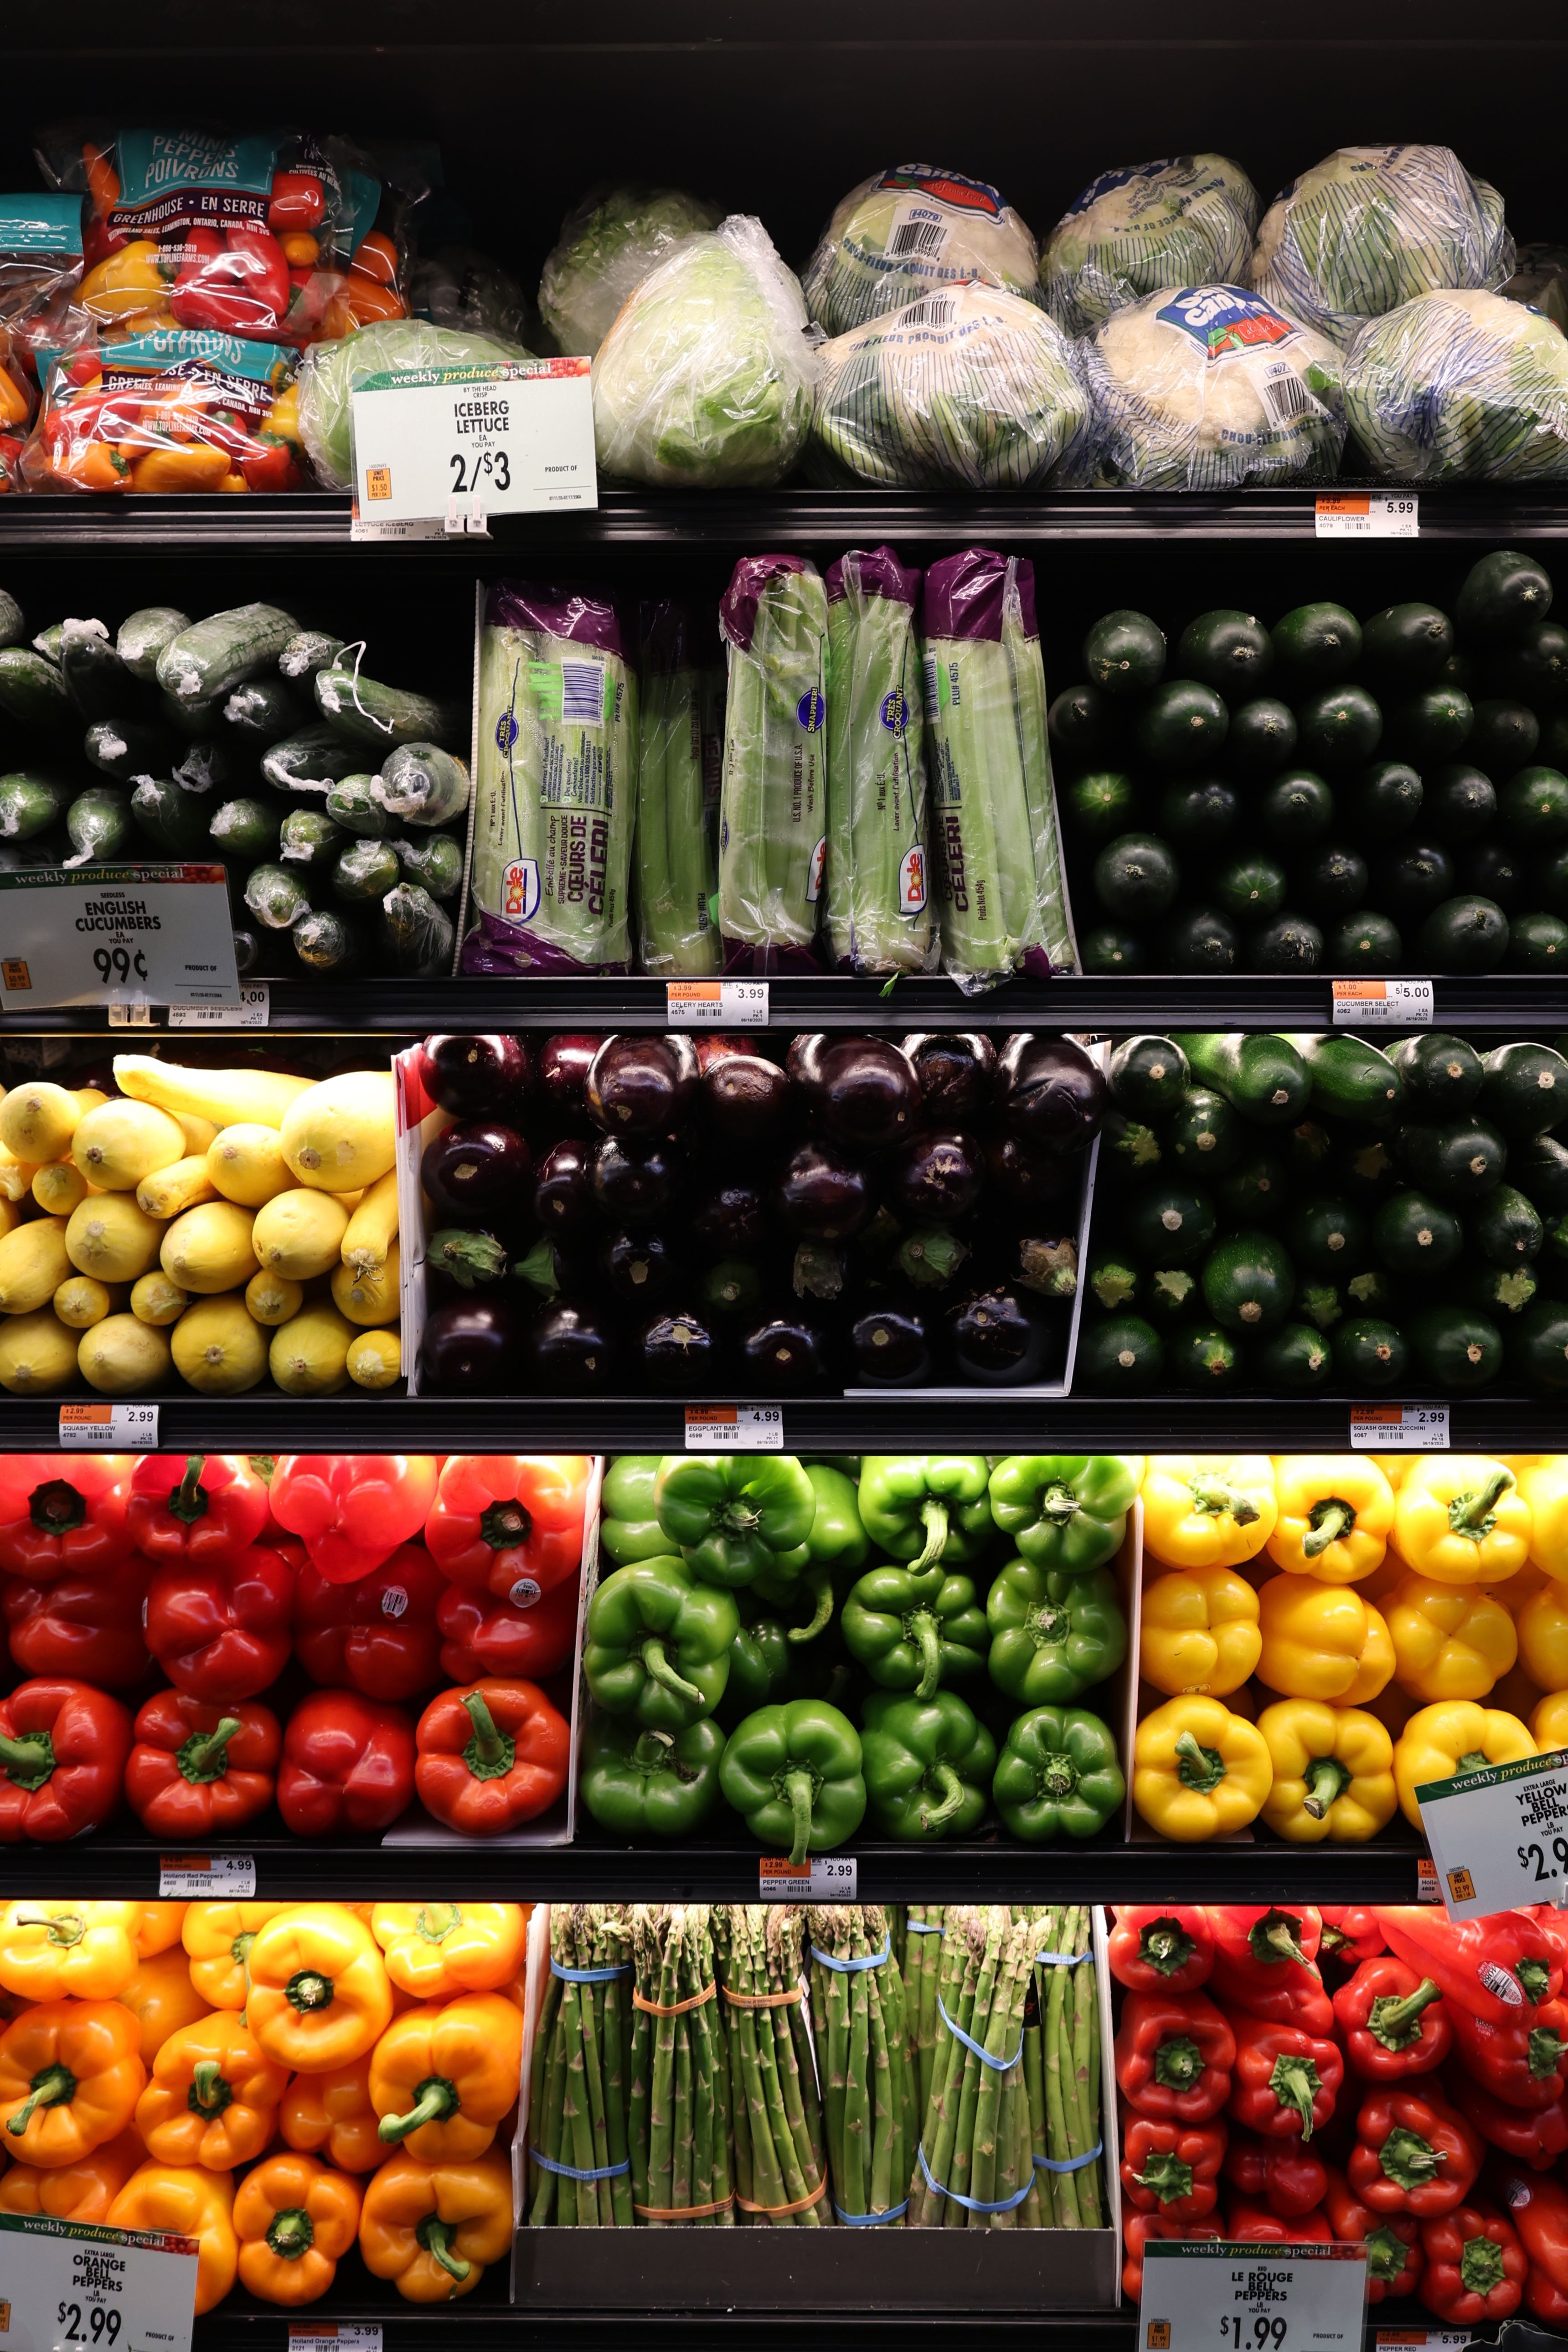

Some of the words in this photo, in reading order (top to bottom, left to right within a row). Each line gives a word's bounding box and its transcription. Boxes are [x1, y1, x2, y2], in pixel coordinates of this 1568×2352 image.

[145, 159, 239, 188] POIVRONS
[113, 197, 183, 224] GREENHOUSE
[201, 196, 217, 210] EN
[223, 198, 264, 217] SERRE
[912, 209, 939, 220] #4079
[193, 217, 218, 228] ONTARIO,
[220, 219, 244, 230] CANADA,
[259, 227, 270, 236] 3V5
[146, 253, 210, 264] WWW.TOPLINEFARMS.COM
[937, 268, 956, 279] DES
[849, 335, 903, 352] CHOU-FLEUR
[908, 330, 954, 345] PRODUIT
[391, 370, 439, 384] weekly
[443, 367, 498, 383] produce
[502, 362, 552, 380] special
[454, 401, 509, 417] ICEBERG
[457, 417, 509, 433] LETTUCE
[949, 662, 958, 683] 4575
[951, 685, 960, 706] PLU#
[807, 687, 819, 732] SNAPPIER!
[884, 699, 895, 722] TRÈS
[892, 685, 903, 739] CROQUANT
[498, 721, 506, 743] TRÈS
[502, 705, 512, 758] CROQUANT
[807, 769, 815, 790] Before
[807, 794, 815, 812] Wash
[547, 815, 560, 844] champ
[571, 815, 587, 837] DE
[549, 846, 555, 857] au
[15, 872, 67, 883] weekly
[71, 869, 129, 883] produce
[133, 867, 185, 879] special
[567, 841, 586, 902] CŒURS
[584, 819, 609, 915] CÉLERI
[907, 852, 921, 902] Dole
[545, 860, 555, 896] Emballé
[975, 880, 985, 894] 454g
[505, 867, 524, 914] Dole
[977, 895, 985, 904] Net
[85, 901, 146, 915] ENGLISH
[978, 906, 986, 920] Poids
[75, 916, 161, 931] CUCUMBERS
[93, 947, 148, 984] 99¢
[1451, 1770, 1497, 1790] weekly
[1500, 1757, 1552, 1780] produce
[1515, 1784, 1567, 1805] YELLOW
[1523, 1784, 1539, 1792] EXTRA
[1539, 1779, 1555, 1788] LARGE
[1531, 1797, 1559, 1813] BELL
[1483, 1968, 1496, 1985] 4088
[23, 2220, 67, 2233] weekly
[68, 2228, 119, 2240] produce
[121, 2232, 165, 2247] special
[1181, 2244, 1227, 2257] weekly
[1230, 2245, 1281, 2257] produce
[1284, 2246, 1331, 2257] special
[73, 2255, 126, 2271] ORANGE
[73, 2275, 123, 2291] PEPPERS
[86, 2267, 111, 2280] BELL
[1232, 2272, 1243, 2281] LE
[1248, 2272, 1293, 2282] ROUGE
[1235, 2291, 1287, 2301] PEPPERS
[1248, 2281, 1274, 2291] BELL
[57, 2300, 121, 2346] $2.99
[1220, 2315, 1287, 2351] $1.99
[145, 2331, 167, 2340] PRODUCT
